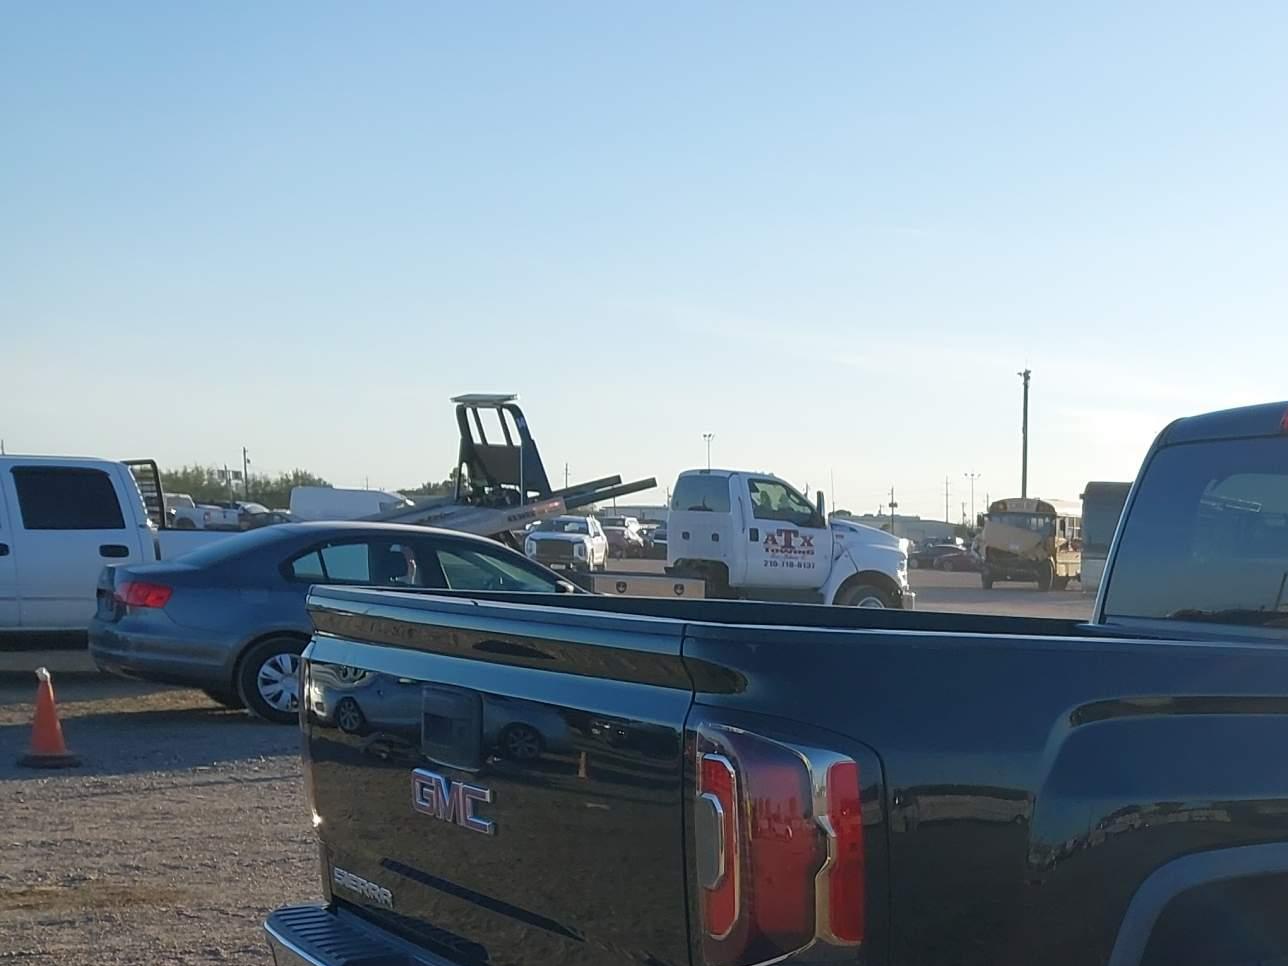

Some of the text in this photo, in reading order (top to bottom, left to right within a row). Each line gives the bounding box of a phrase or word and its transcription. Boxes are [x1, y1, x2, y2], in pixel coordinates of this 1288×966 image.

[763, 528, 815, 549] ATX
[411, 768, 495, 835] GMC
[335, 867, 393, 908] SIERRA
